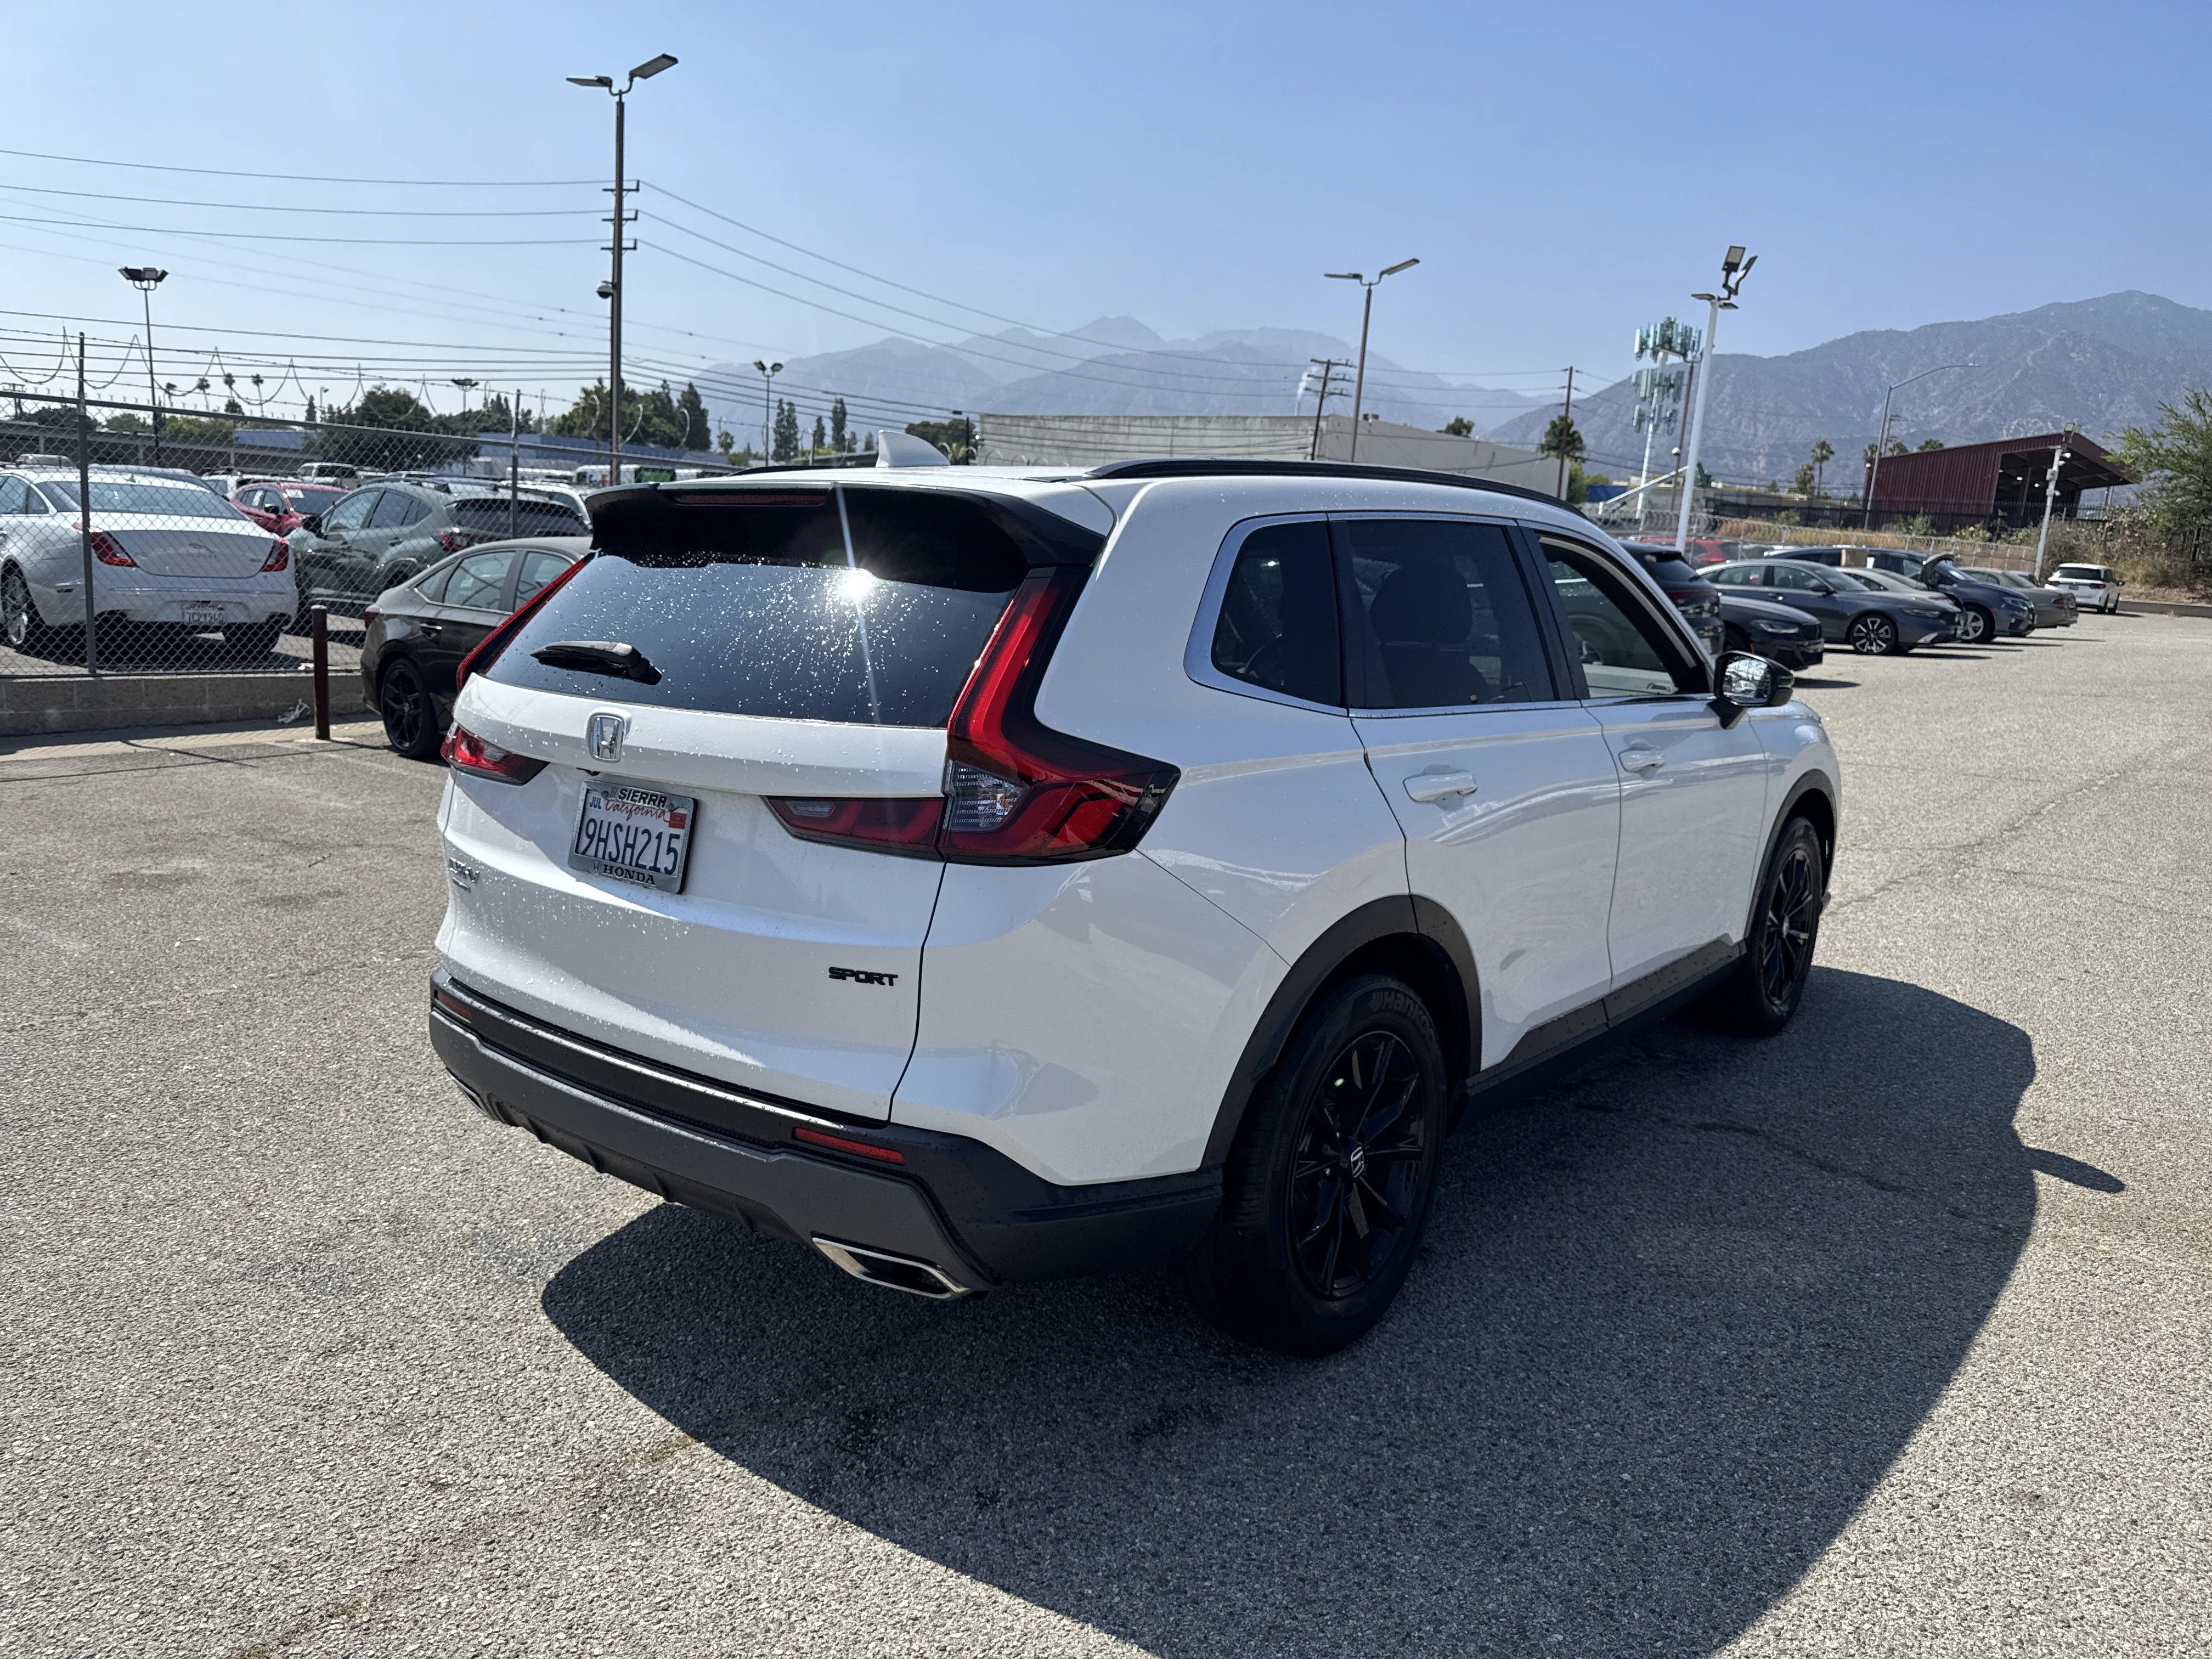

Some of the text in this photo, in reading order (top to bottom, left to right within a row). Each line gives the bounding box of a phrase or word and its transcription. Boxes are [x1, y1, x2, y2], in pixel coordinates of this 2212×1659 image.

[589, 796, 602, 809] JUL
[618, 788, 667, 808] SIERRA
[605, 799, 669, 822] California
[581, 817, 680, 875] 9HSH215
[603, 864, 656, 885] HONDA
[828, 966, 899, 986] SPORT
